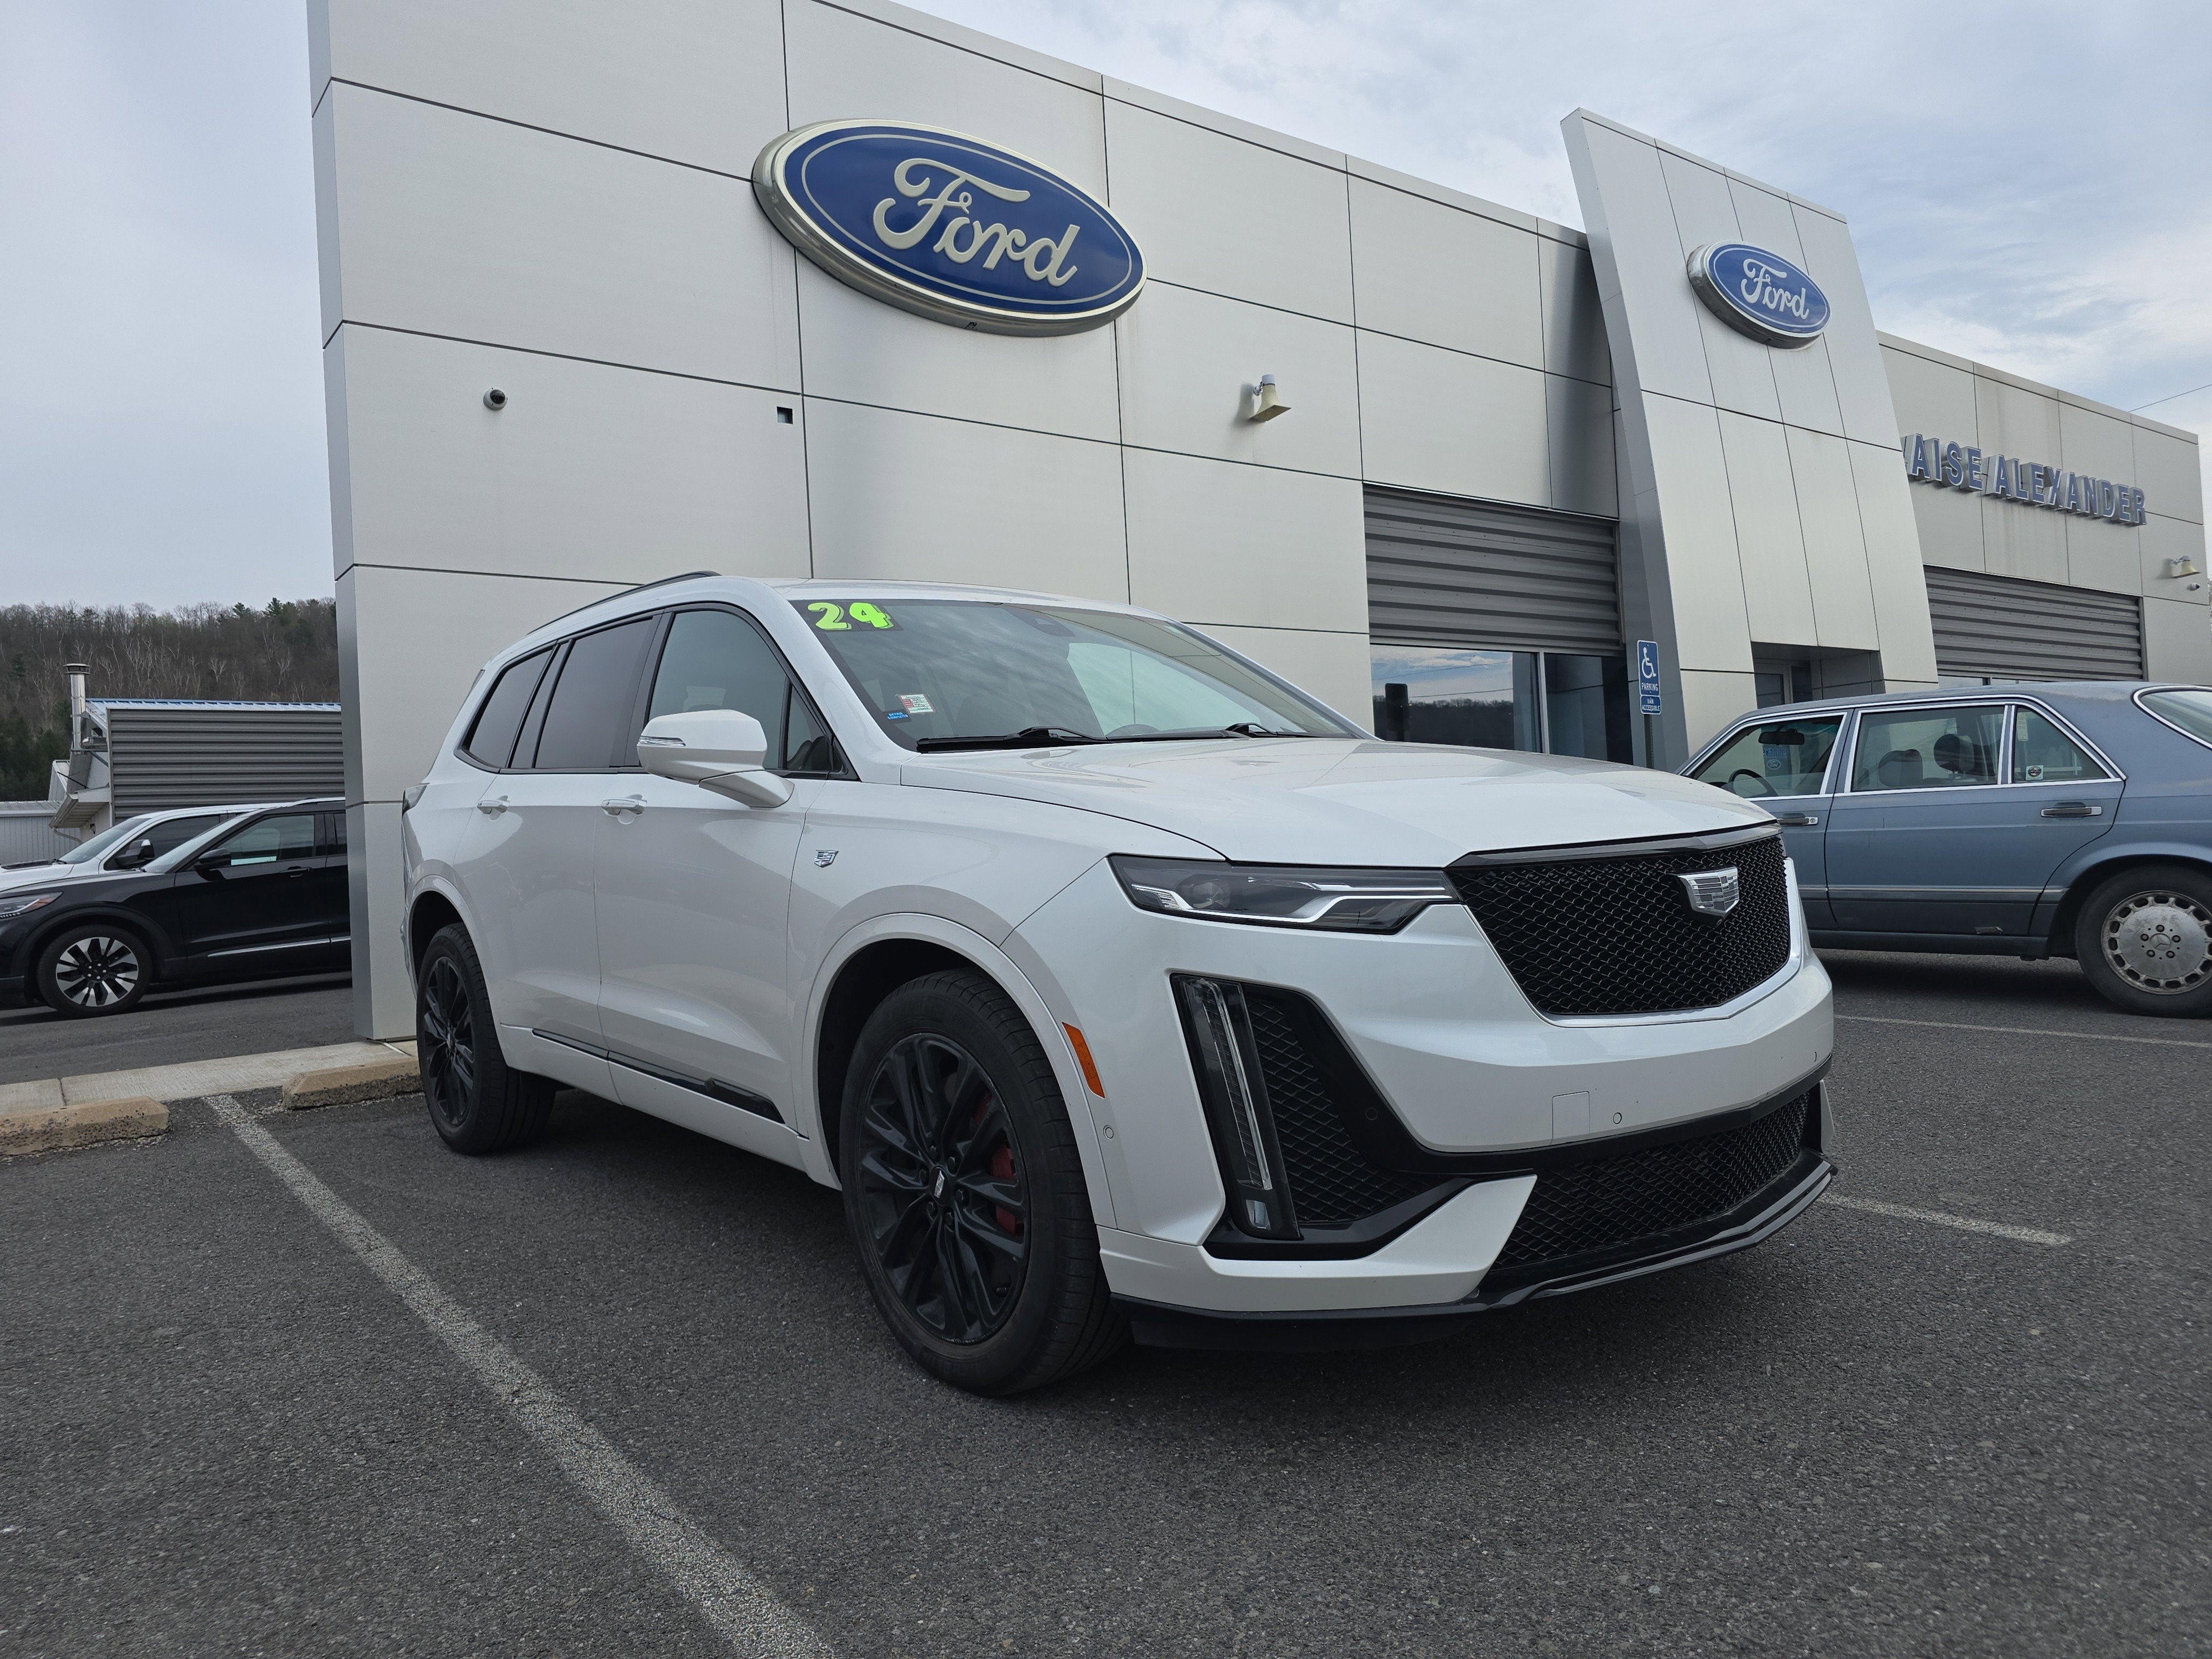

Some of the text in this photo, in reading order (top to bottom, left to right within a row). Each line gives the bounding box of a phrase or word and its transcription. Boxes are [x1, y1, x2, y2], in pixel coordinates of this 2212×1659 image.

[872, 157, 1081, 287] Ford
[1740, 258, 1810, 320] Ford
[1904, 433, 2147, 526] AISE ALEXANDER
[807, 602, 894, 631] 24
[1641, 682, 1658, 691] PARKING
